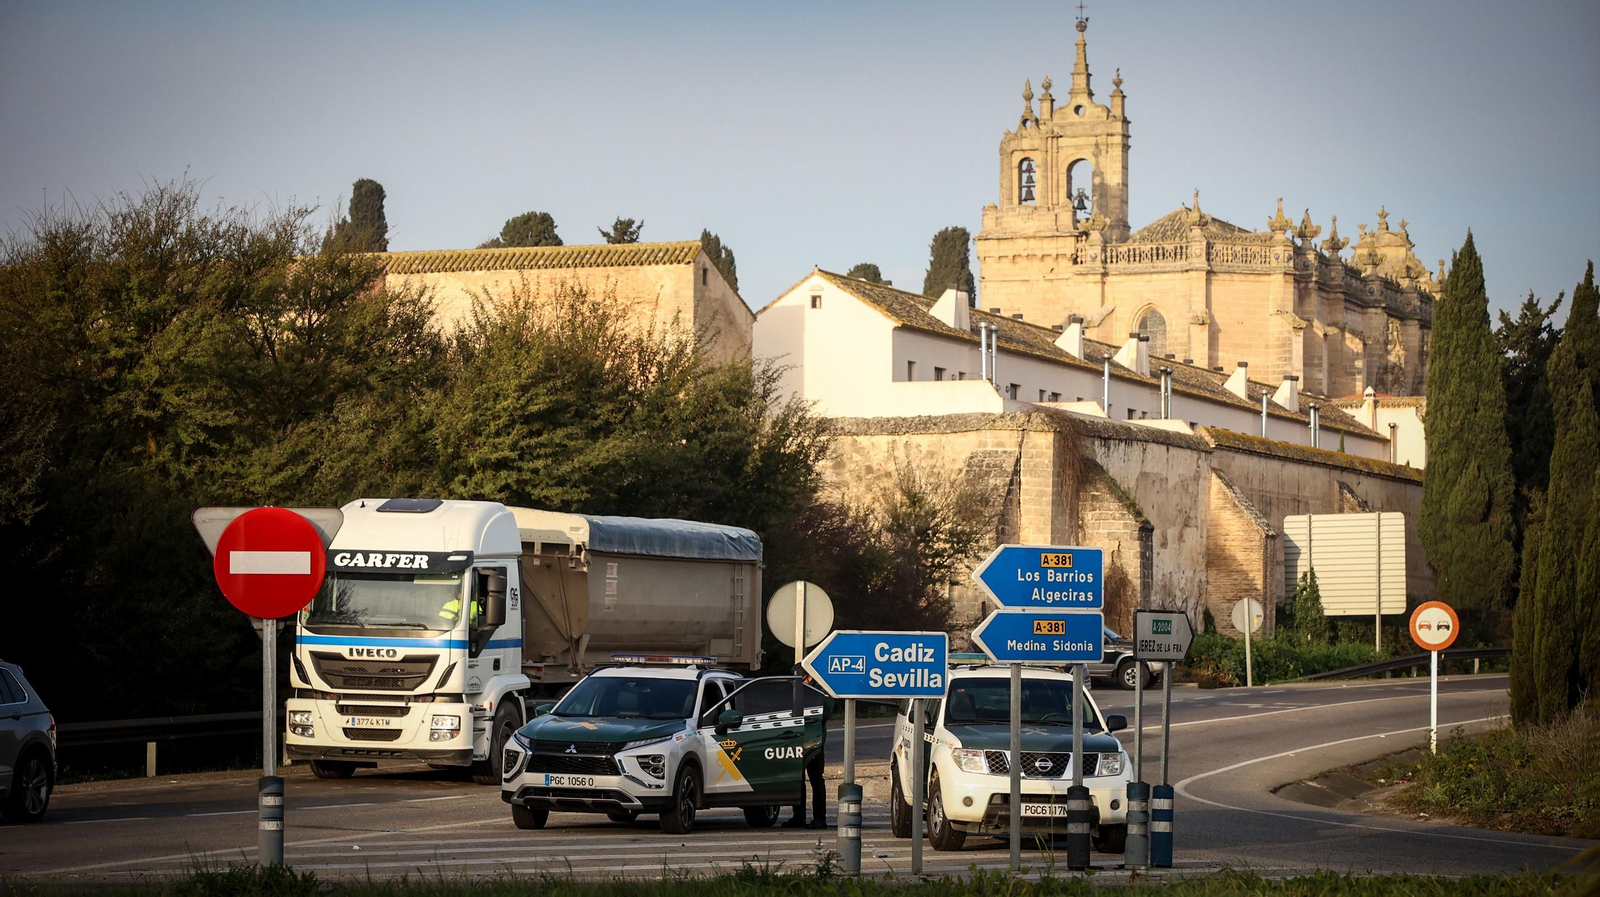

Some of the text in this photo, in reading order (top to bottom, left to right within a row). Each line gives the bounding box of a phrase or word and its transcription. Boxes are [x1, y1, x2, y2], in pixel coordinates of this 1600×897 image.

[334, 552, 429, 569] GARFER
[1042, 555, 1072, 566] A-381
[1017, 568, 1094, 583] Los Barrios
[1031, 587, 1094, 604] Algeciras
[1035, 622, 1065, 633] A-381
[1152, 622, 1171, 632] A-2004
[1007, 639, 1094, 652] Medina Sidonia
[1138, 640, 1156, 653] JEREZ
[1156, 644, 1163, 652] DE
[1164, 644, 1171, 652] LA
[348, 647, 397, 658] IVECO
[874, 642, 935, 663] Cadiz
[830, 658, 864, 672] AP-4
[868, 667, 942, 688] Sevilla
[356, 718, 374, 726] 3774
[764, 746, 804, 760] GUAR
[550, 775, 565, 786] PGC
[567, 776, 587, 786] 1056
